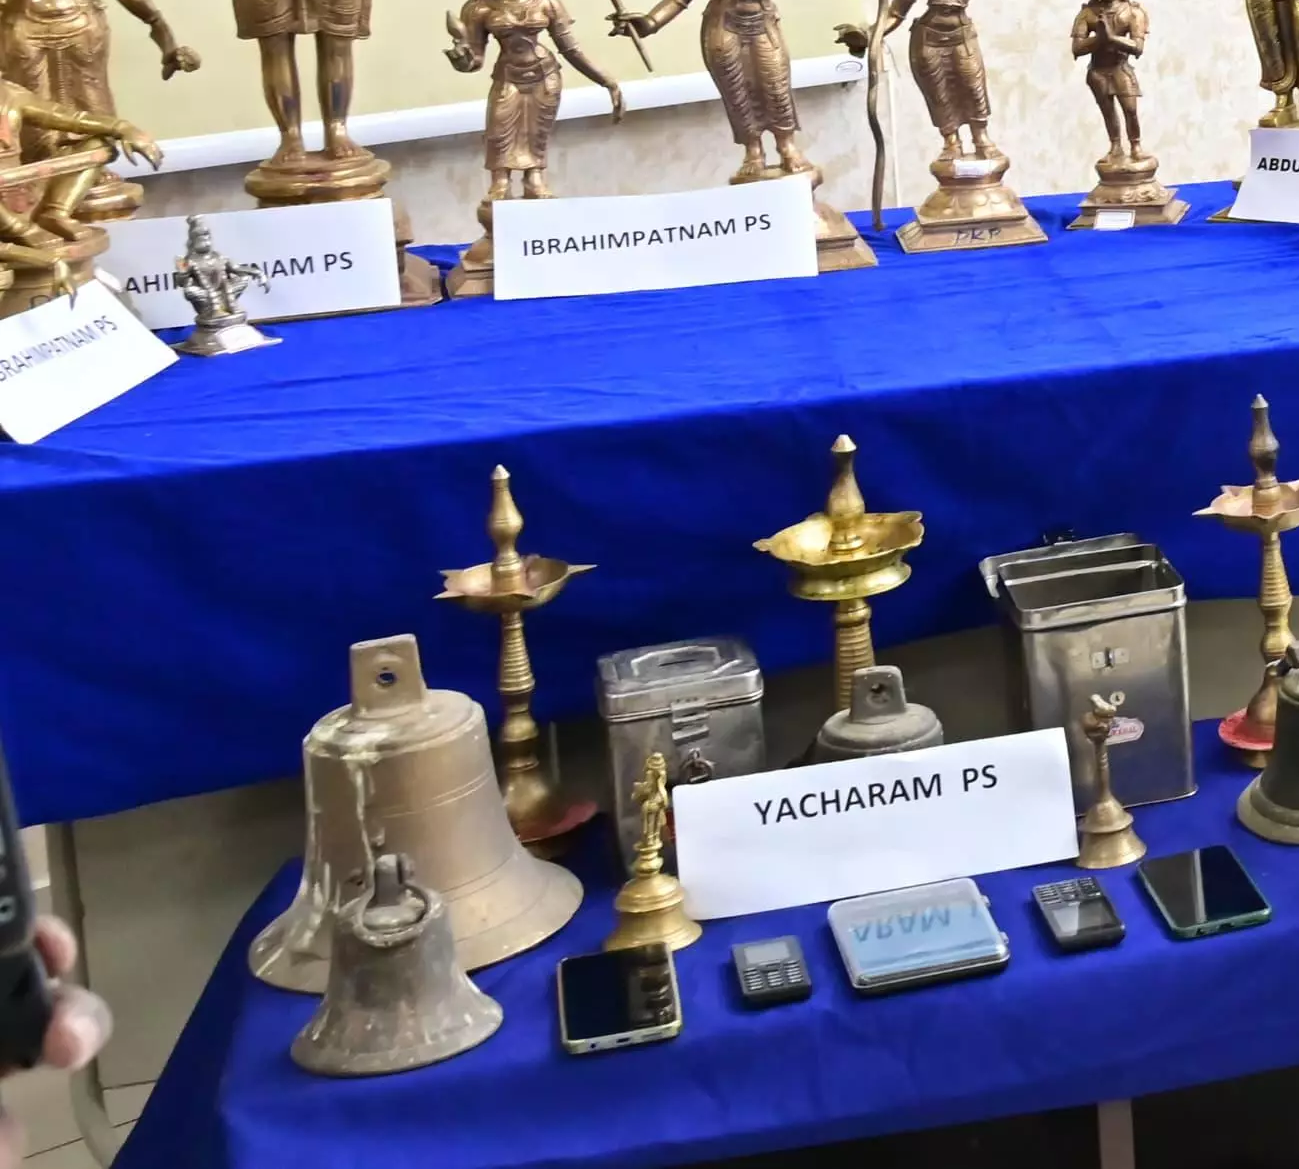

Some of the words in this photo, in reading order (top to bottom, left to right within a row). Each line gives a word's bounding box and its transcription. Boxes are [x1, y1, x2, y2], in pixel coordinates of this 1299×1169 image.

[522, 218, 736, 257] IBRAHIMPATNAM
[744, 213, 772, 232] PS
[323, 251, 354, 273] PS
[93, 315, 118, 336] PS
[753, 773, 942, 826] YACHARAM
[962, 764, 998, 792] PS
